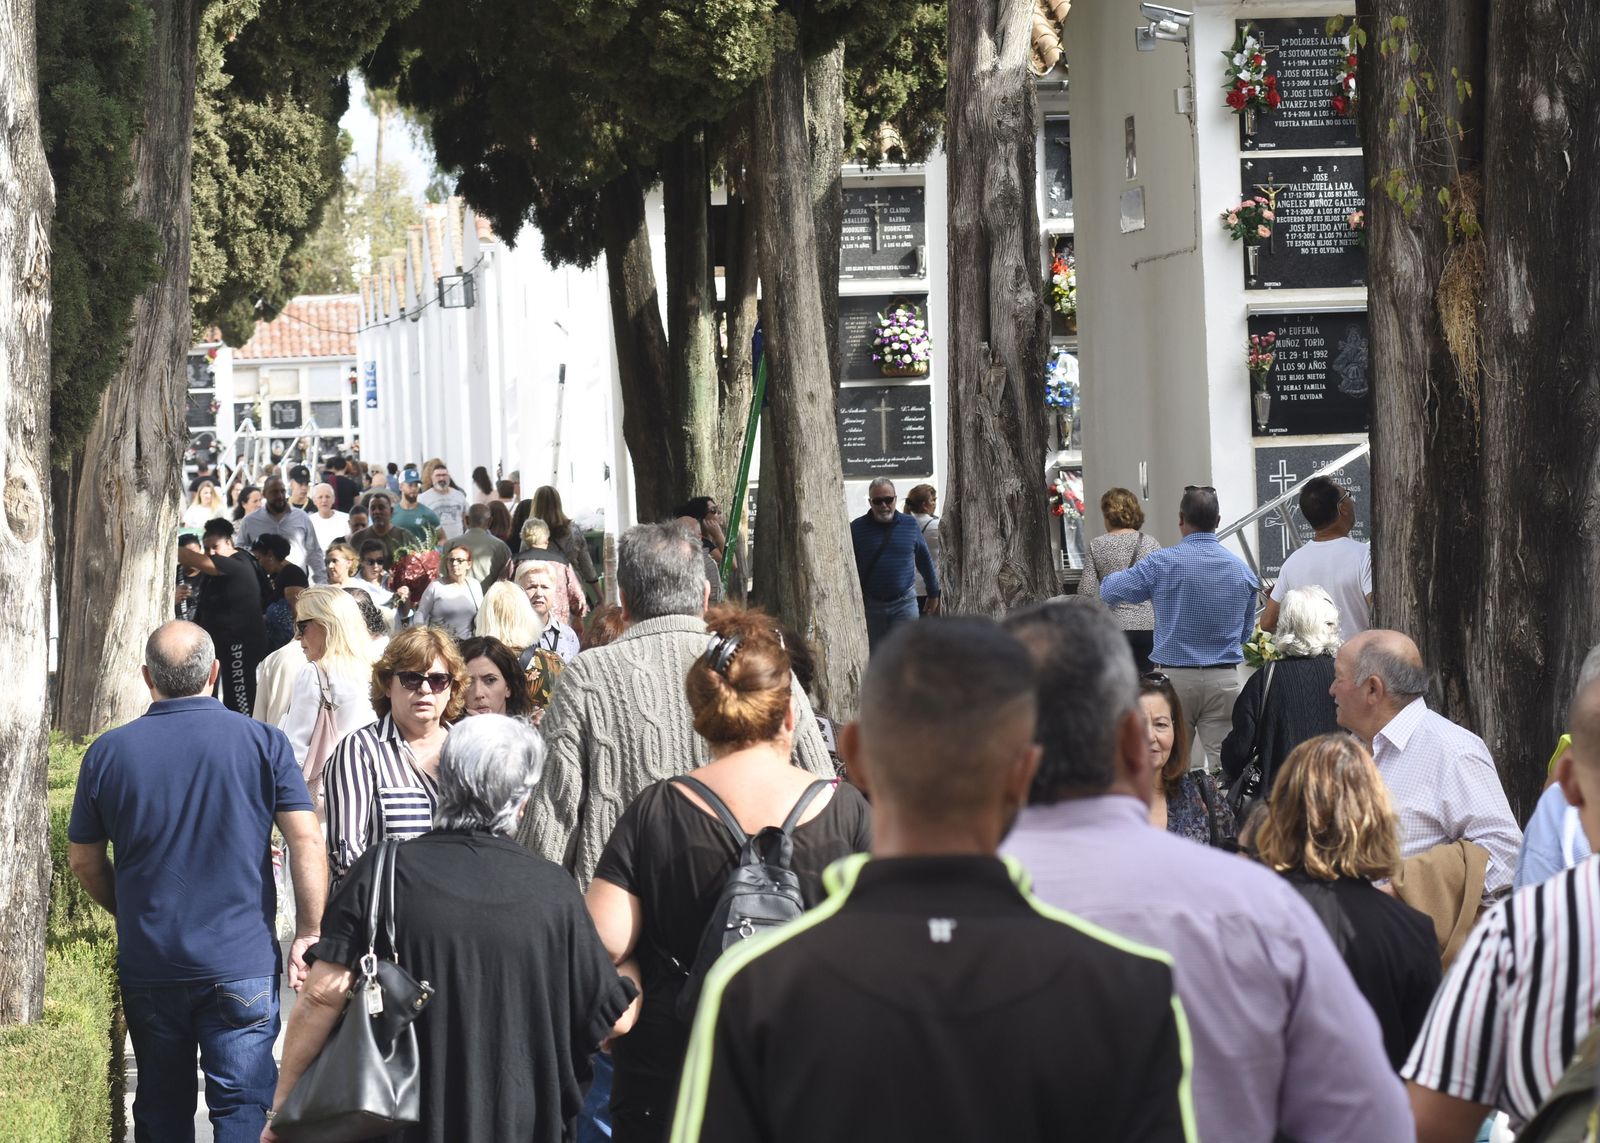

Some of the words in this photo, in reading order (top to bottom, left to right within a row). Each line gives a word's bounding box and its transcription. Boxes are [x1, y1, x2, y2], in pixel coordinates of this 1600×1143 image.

[1290, 37, 1319, 46] DOLORES
[1320, 36, 1343, 46] ALVAR
[1288, 49, 1328, 57] SOTOMAYOR
[1284, 70, 1300, 78] JOSE
[1302, 68, 1329, 77] ORTEGA
[1277, 100, 1308, 109] ALVAREZ
[1312, 173, 1328, 181] JOSE
[1289, 183, 1333, 191] VALENZUELA
[1335, 182, 1354, 190] LARA
[1277, 200, 1307, 208] ANGELES
[1309, 198, 1333, 208] MUÑOZ
[1335, 198, 1365, 207] GALLEGO
[1289, 326, 1320, 335] EUFEMIA
[1276, 338, 1300, 348] MUÑOZ
[1304, 338, 1325, 347] TORIO
[1279, 351, 1287, 360] EL
[1308, 361, 1326, 370] AÑOS
[231, 644, 245, 692] SPORTS
